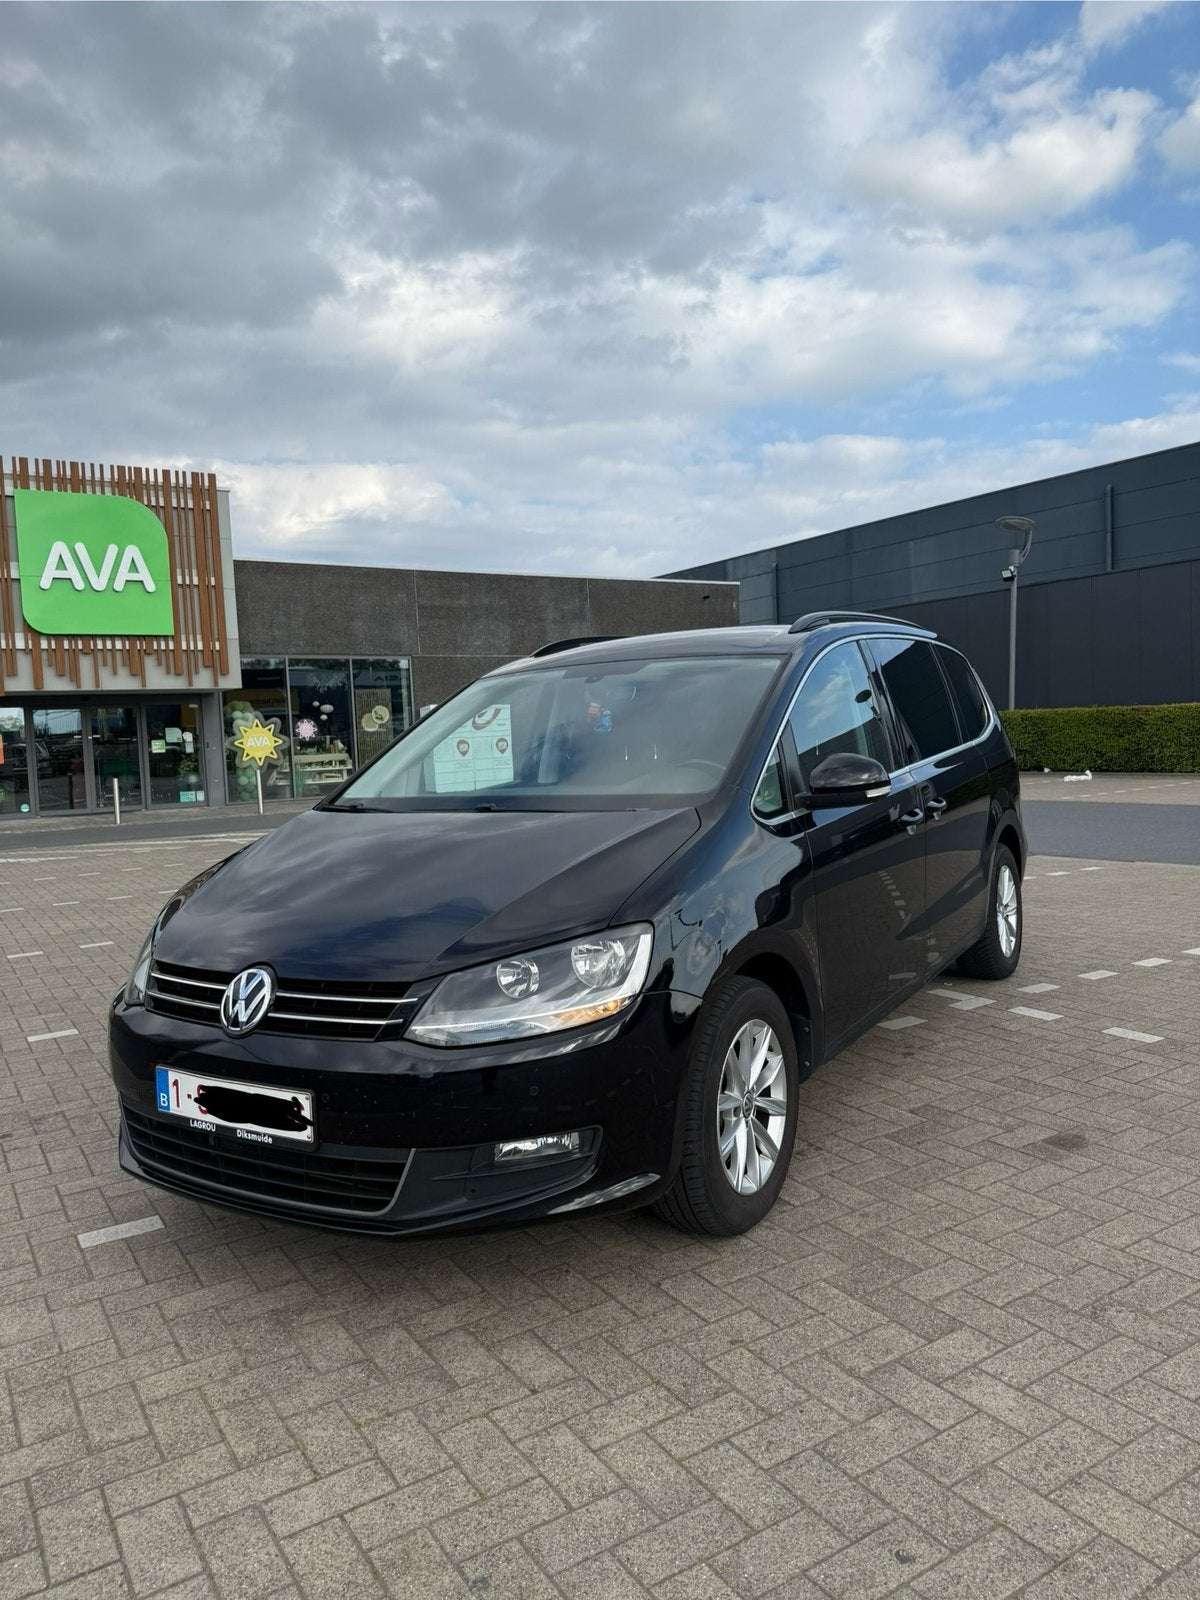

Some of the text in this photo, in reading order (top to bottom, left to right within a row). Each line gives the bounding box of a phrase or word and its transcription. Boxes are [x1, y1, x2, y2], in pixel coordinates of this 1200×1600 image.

[40, 541, 156, 593] AVA
[246, 736, 271, 748] AVA
[160, 1092, 168, 1107] B
[189, 1119, 273, 1144] LAGROU Diksmuide
